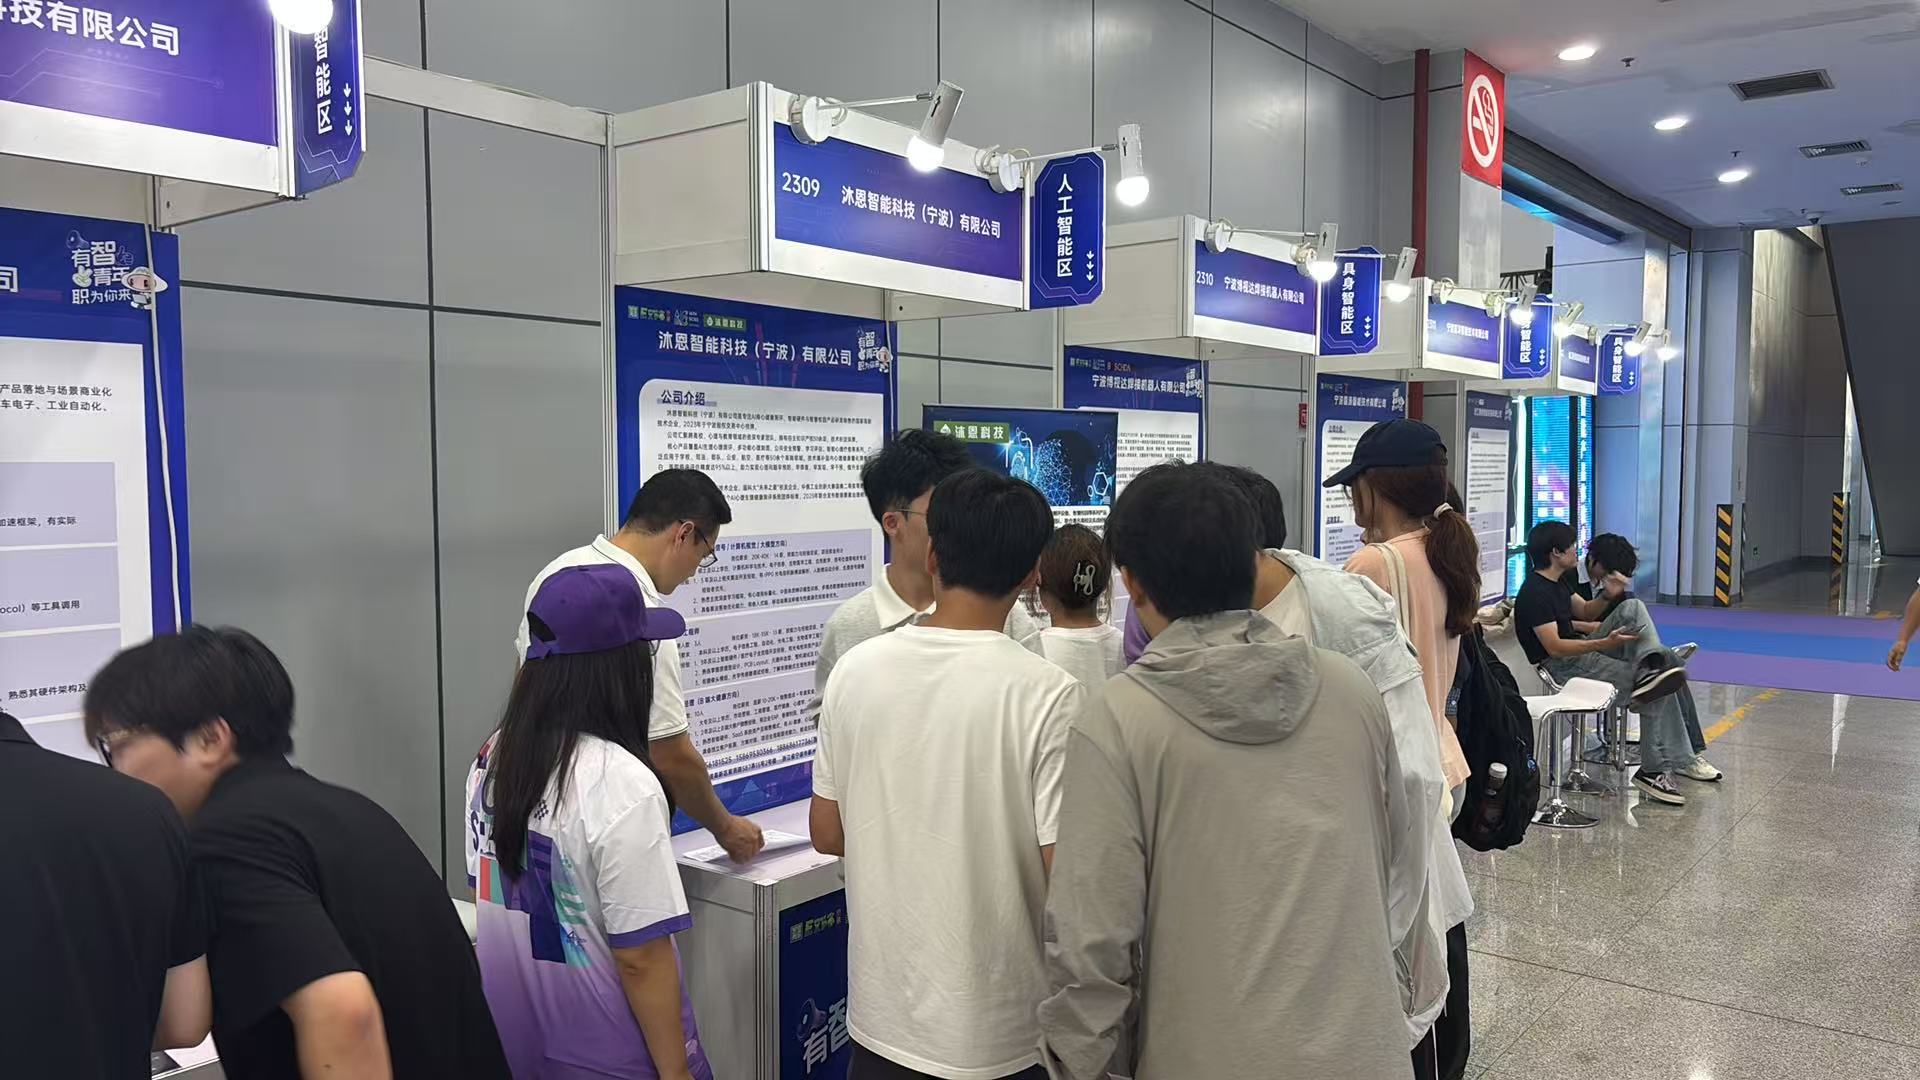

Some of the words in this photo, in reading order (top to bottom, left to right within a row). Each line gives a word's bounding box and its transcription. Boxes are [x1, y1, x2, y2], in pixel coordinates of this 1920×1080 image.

[0, 0, 180, 56] 技有限公司
[782, 172, 820, 198] 2309
[841, 185, 1001, 239] 沐恩智能科技（宁波）有限公司
[1057, 173, 1073, 277] 人工智能区
[71, 240, 117, 268] 有智
[1196, 271, 1214, 286] 2310
[71, 289, 132, 305] 职为你来
[1341, 262, 1356, 334] 具身智能区
[659, 331, 852, 366] 沐恩智能科技（宁波）有限公司
[0, 384, 112, 397] 产品落地与场景商业化
[661, 390, 706, 406] 公司介绍
[954, 425, 1004, 440] 沐恩科技
